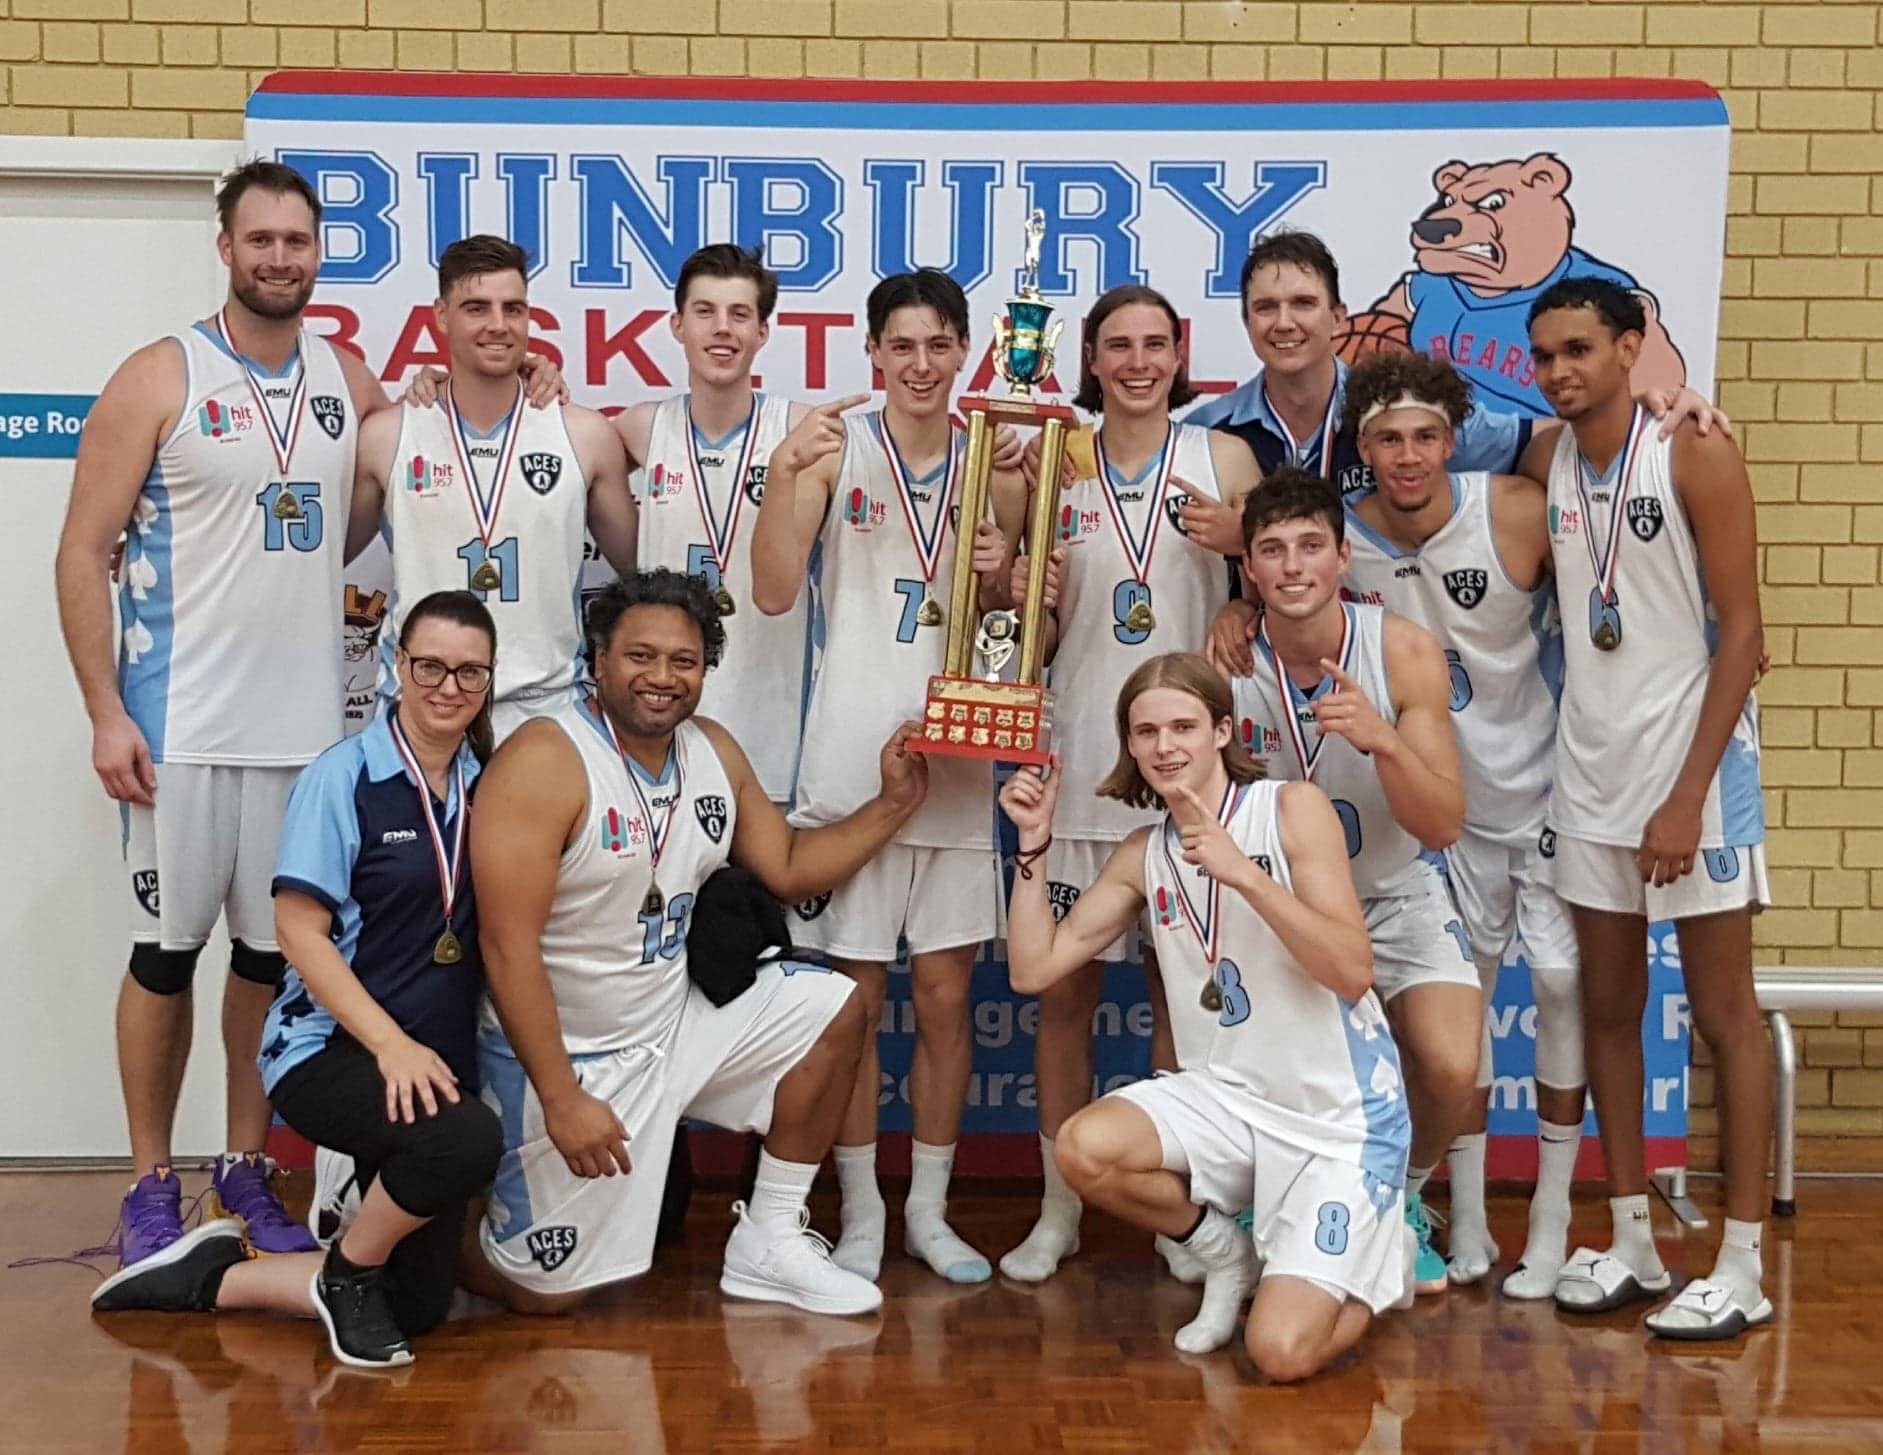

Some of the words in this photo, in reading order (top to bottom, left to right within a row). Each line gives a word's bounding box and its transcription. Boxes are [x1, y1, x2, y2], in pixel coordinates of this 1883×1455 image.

[275, 148, 1327, 299] BUNBURY
[1430, 327, 1537, 387] BEARS
[231, 406, 252, 420] hit
[313, 397, 344, 416] ACES
[47, 411, 86, 434] Ro
[433, 464, 453, 477] hit
[525, 455, 561, 473] ACES
[667, 472, 684, 485] hit
[747, 468, 768, 483] ACE
[1341, 466, 1376, 490] ACE
[911, 491, 931, 504] MU
[1629, 498, 1661, 517] ACES
[256, 482, 323, 552] 15
[1080, 511, 1100, 523] hit
[1561, 510, 1578, 523] hit
[457, 536, 519, 602] 11
[1447, 571, 1485, 590] ACES
[1361, 590, 1384, 604] hit
[895, 577, 925, 643] 7
[1113, 579, 1152, 645] 9
[695, 798, 726, 818] ACES
[627, 817, 646, 833] hit
[136, 872, 157, 893] AC
[637, 892, 694, 965] 13
[1216, 957, 1252, 1028] 8
[1315, 1200, 1350, 1256] 8
[530, 1228, 575, 1252] ACES
